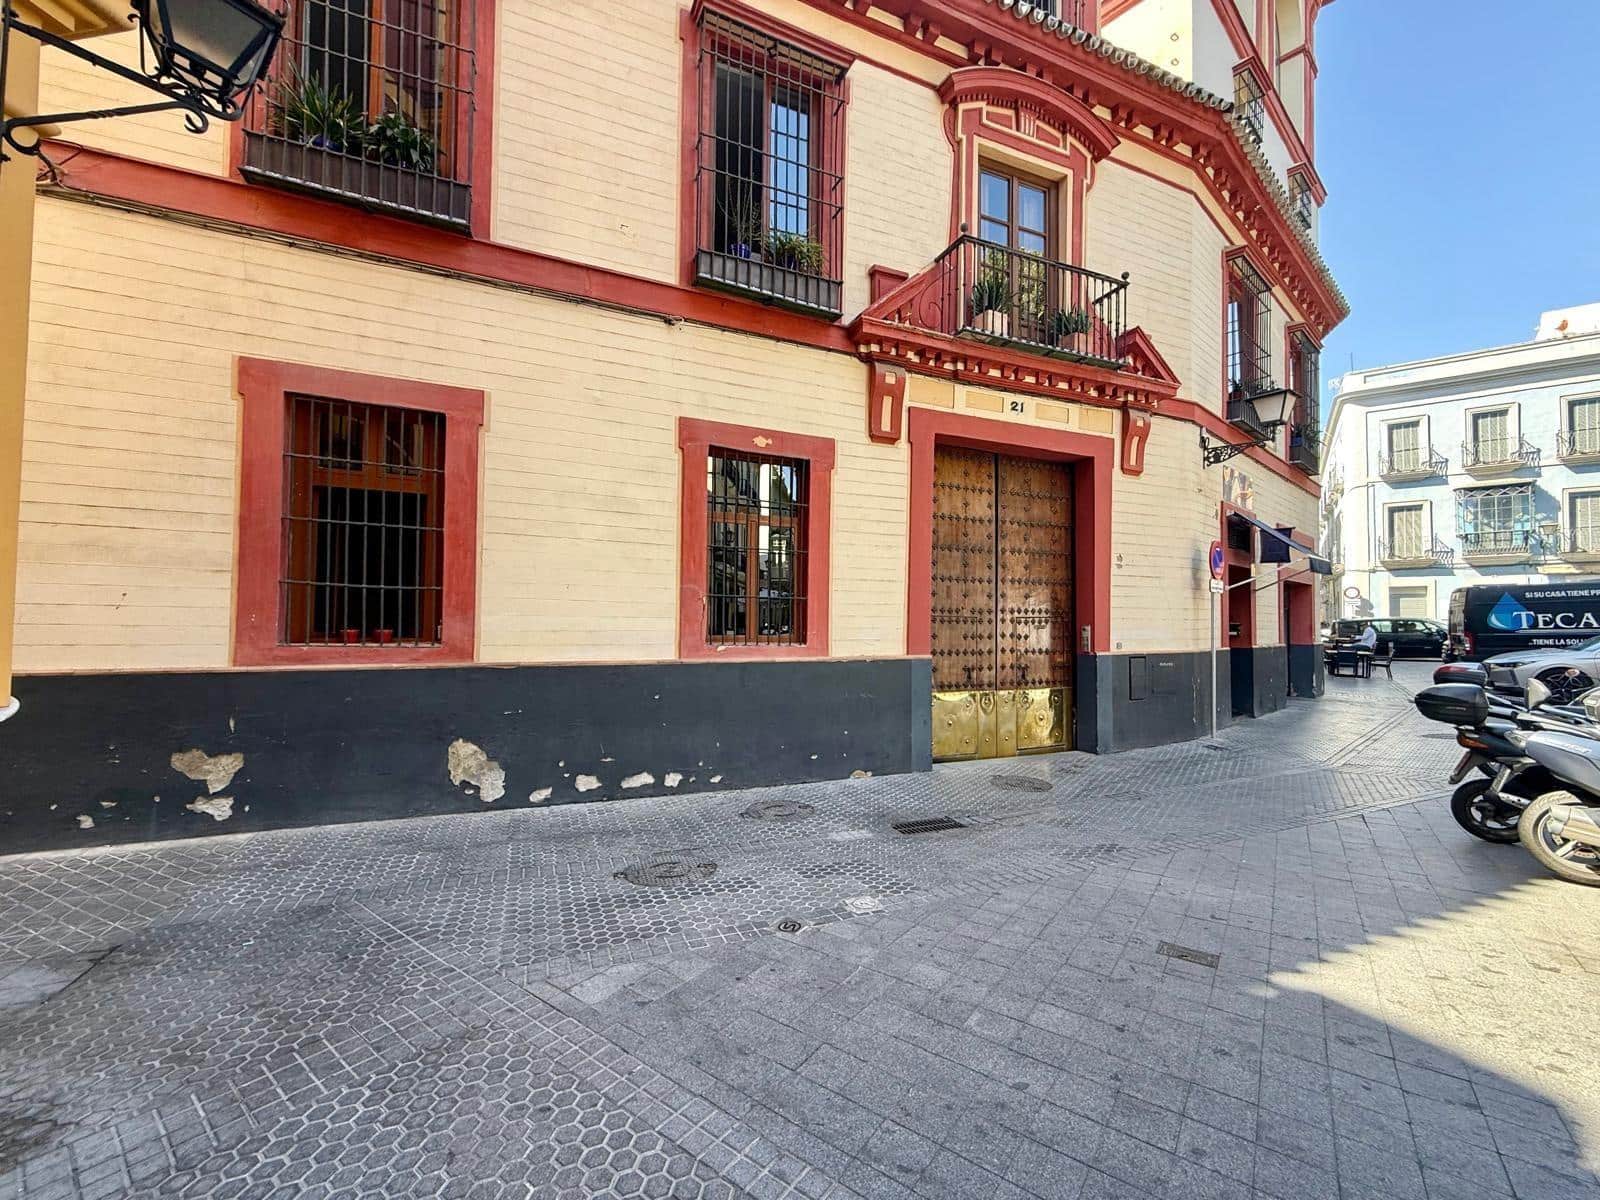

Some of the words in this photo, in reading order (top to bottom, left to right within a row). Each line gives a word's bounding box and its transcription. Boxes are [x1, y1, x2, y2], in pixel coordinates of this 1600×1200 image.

[1010, 401, 1024, 413] 21
[1545, 590, 1567, 598] CASA
[1555, 638, 1566, 646] LA
